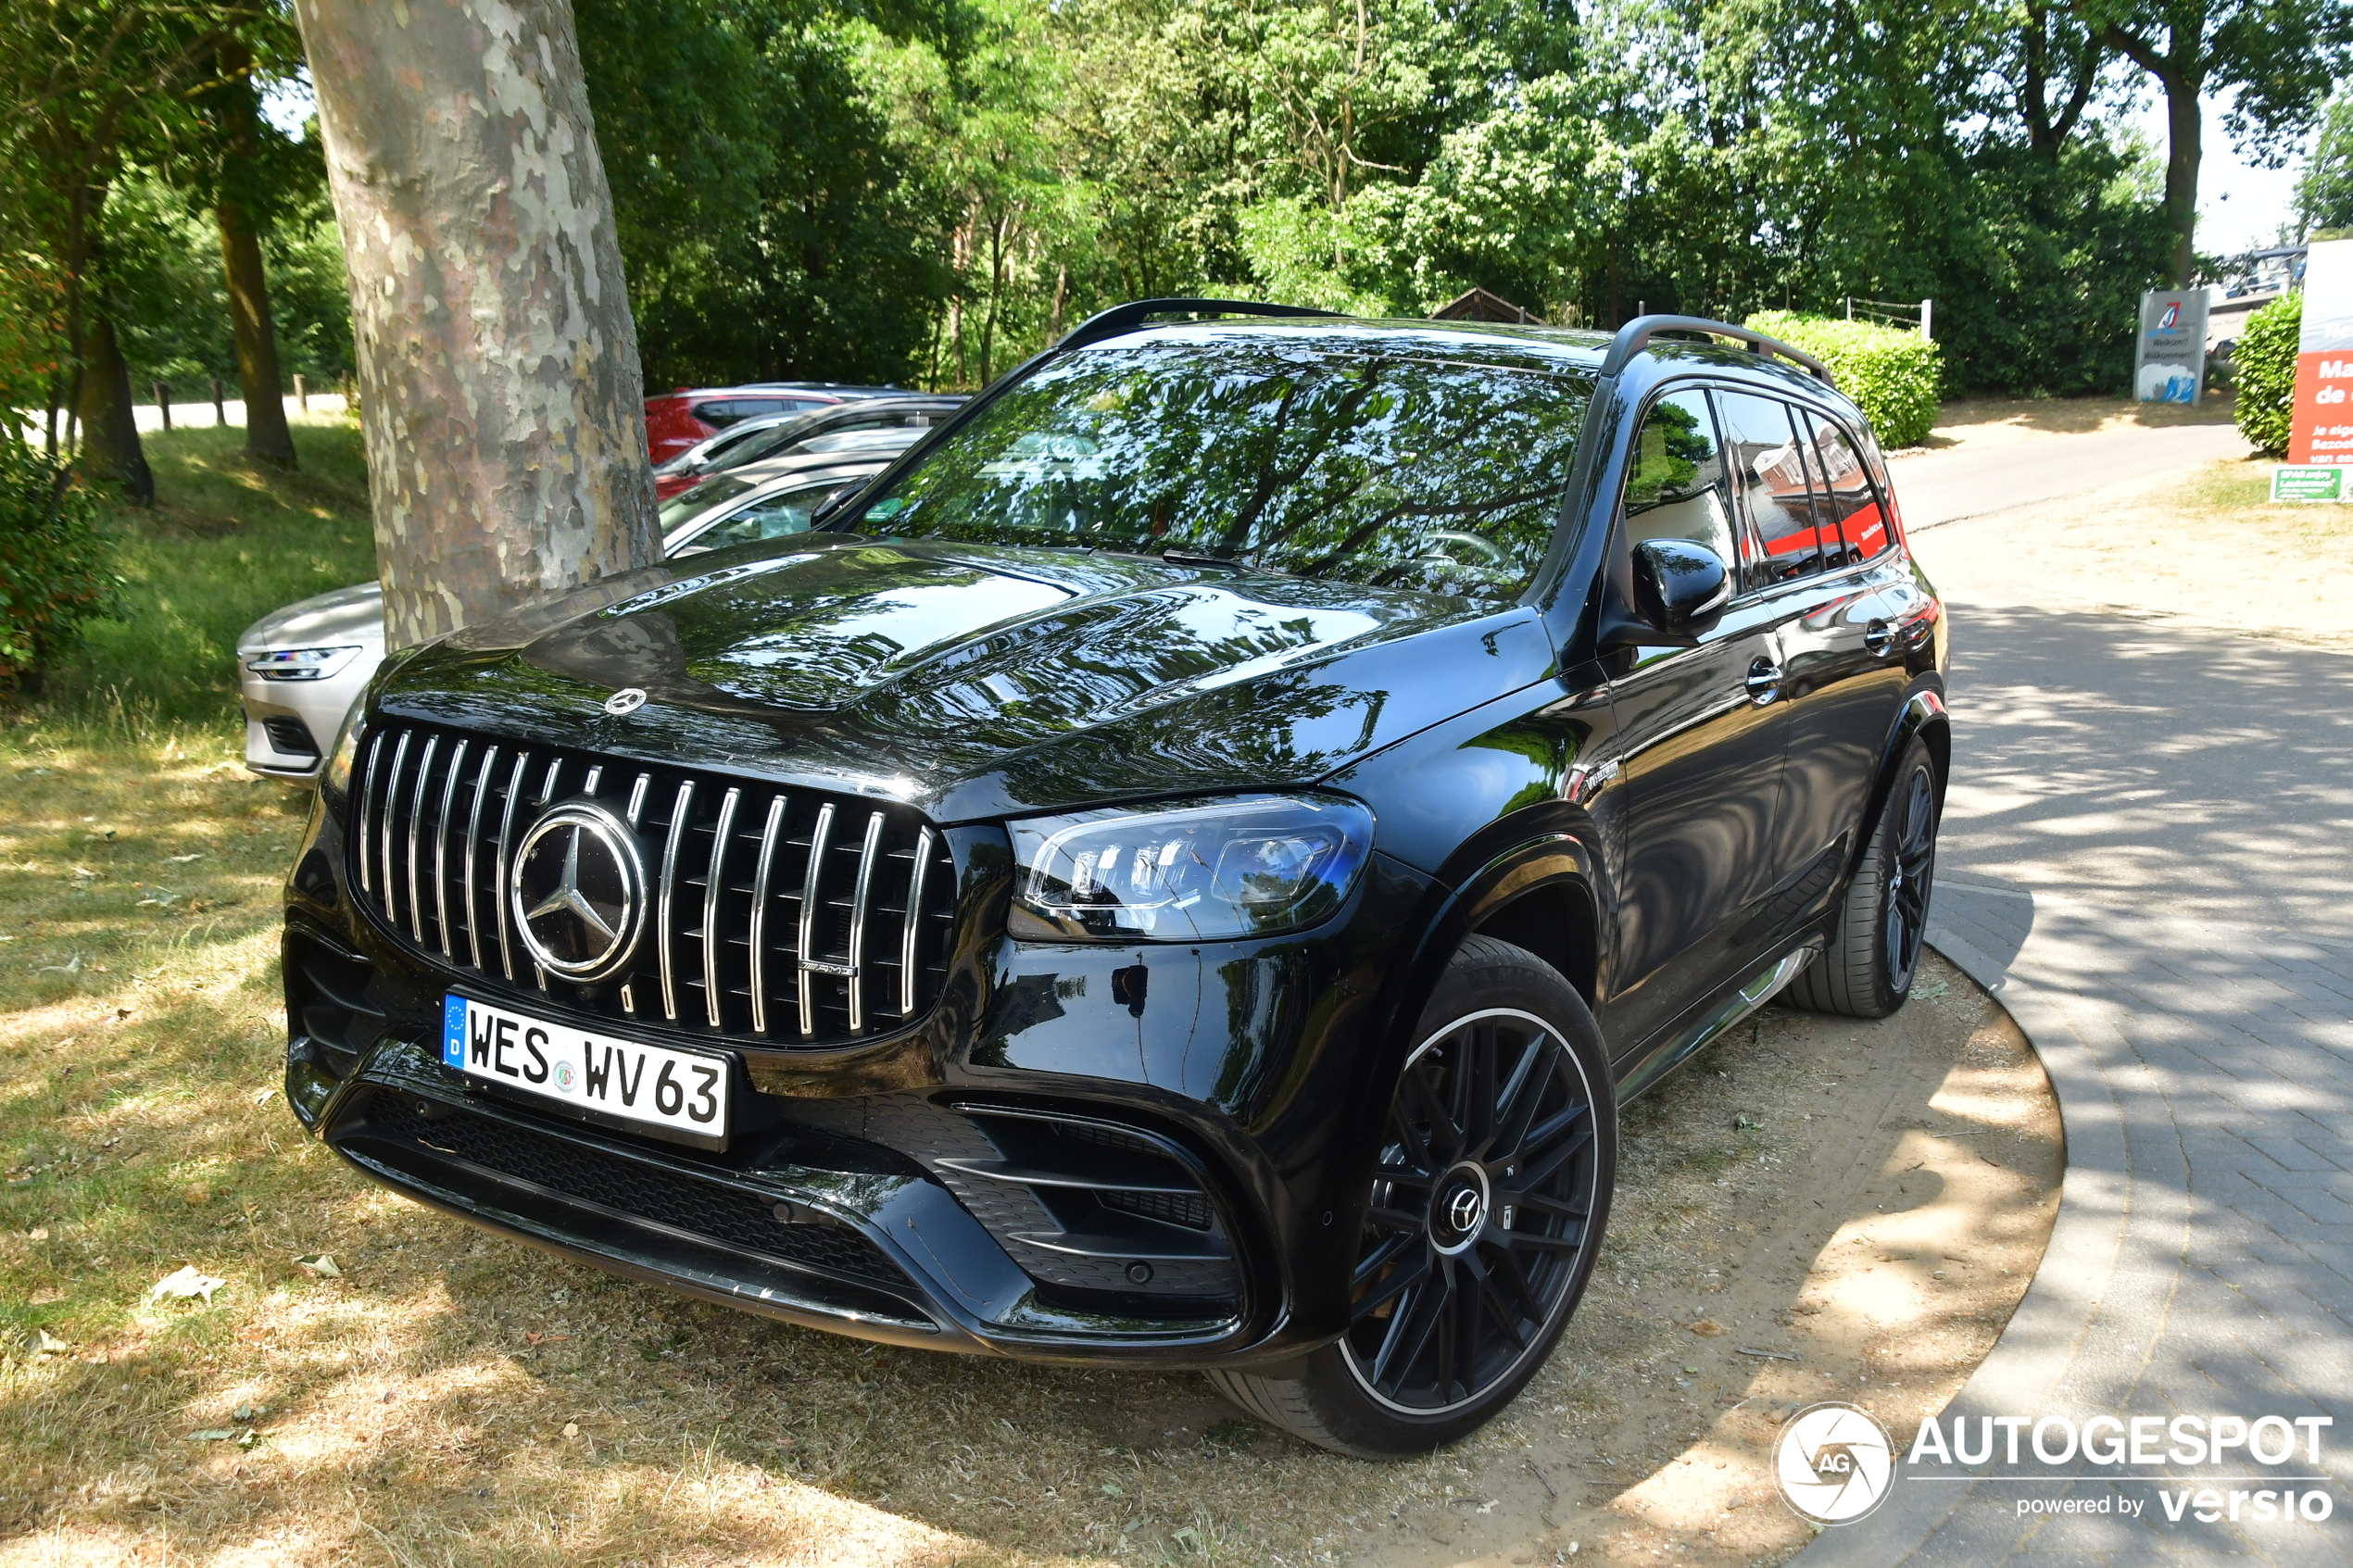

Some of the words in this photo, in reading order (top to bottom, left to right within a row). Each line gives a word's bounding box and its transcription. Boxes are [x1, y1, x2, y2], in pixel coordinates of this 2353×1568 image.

[2323, 322, 2353, 339] Ne
[2316, 385, 2345, 404] de
[2311, 424, 2327, 437] Je
[2309, 454, 2334, 465] van
[2335, 454, 2353, 465] ee
[816, 964, 853, 975] AMG
[450, 1038, 460, 1055] D
[471, 1009, 549, 1084] WES
